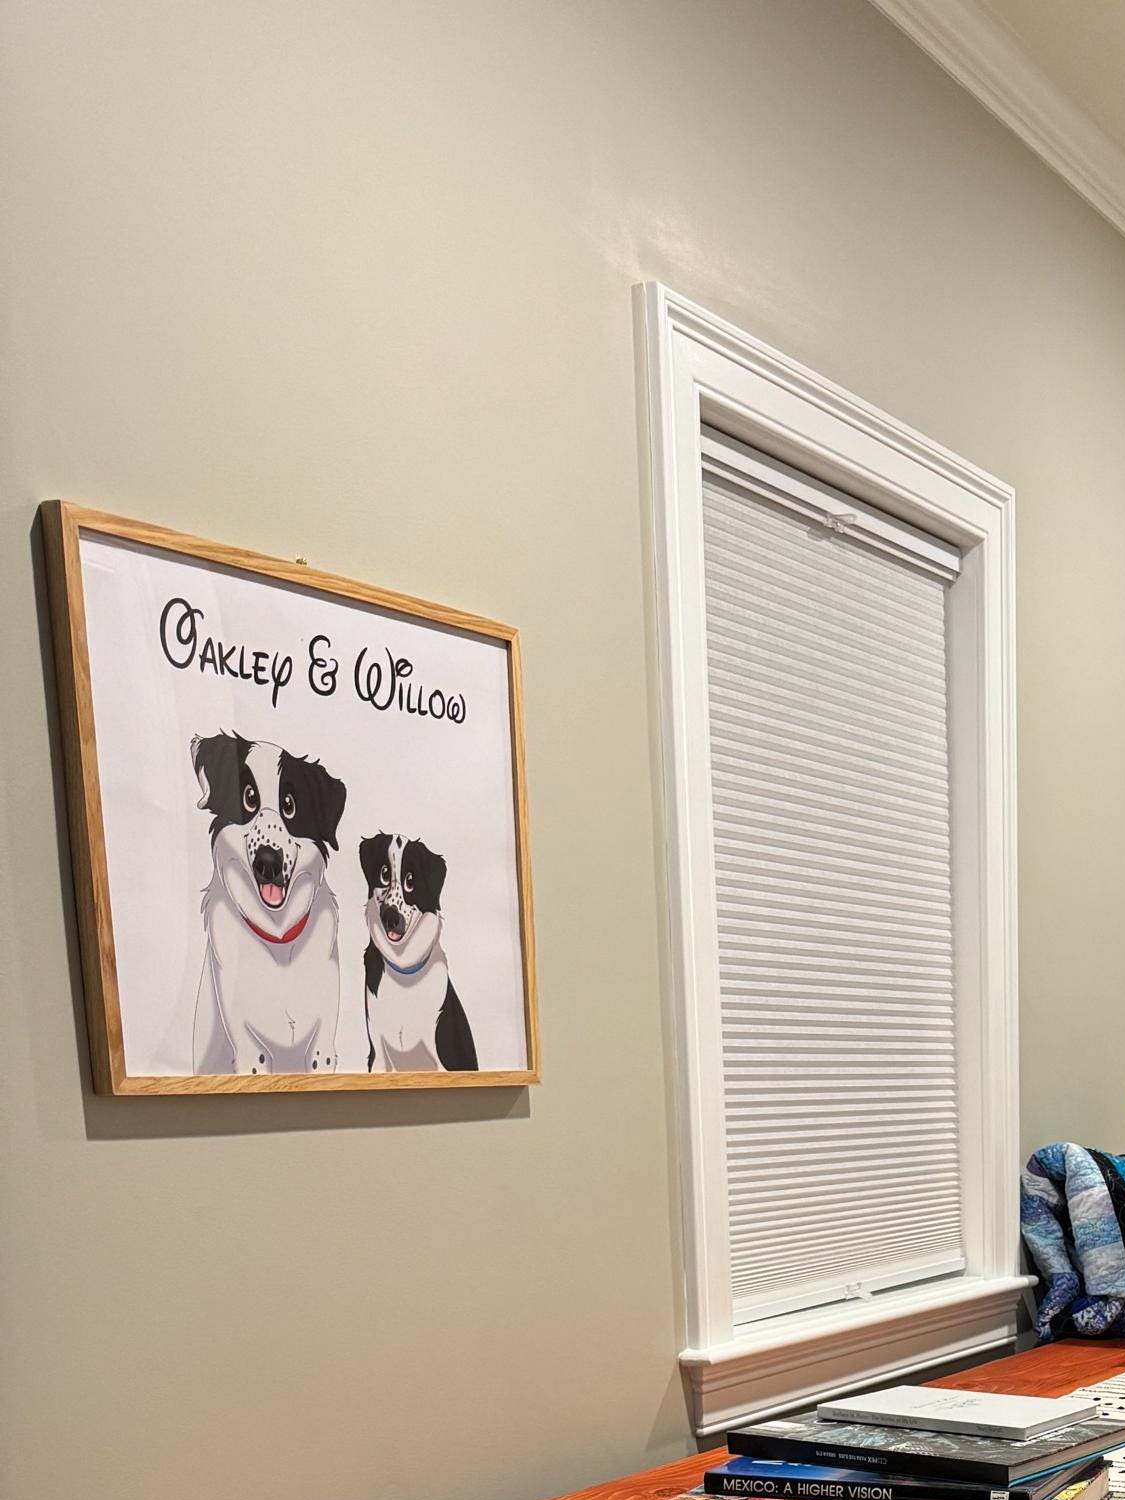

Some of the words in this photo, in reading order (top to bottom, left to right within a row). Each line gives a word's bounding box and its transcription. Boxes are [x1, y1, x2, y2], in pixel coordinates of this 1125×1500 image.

[308, 634, 339, 696] &
[723, 1478, 779, 1494] MEXICO:
[783, 1482, 793, 1494] A
[797, 1483, 844, 1498] HIGHER
[848, 1486, 892, 1500] VISION
